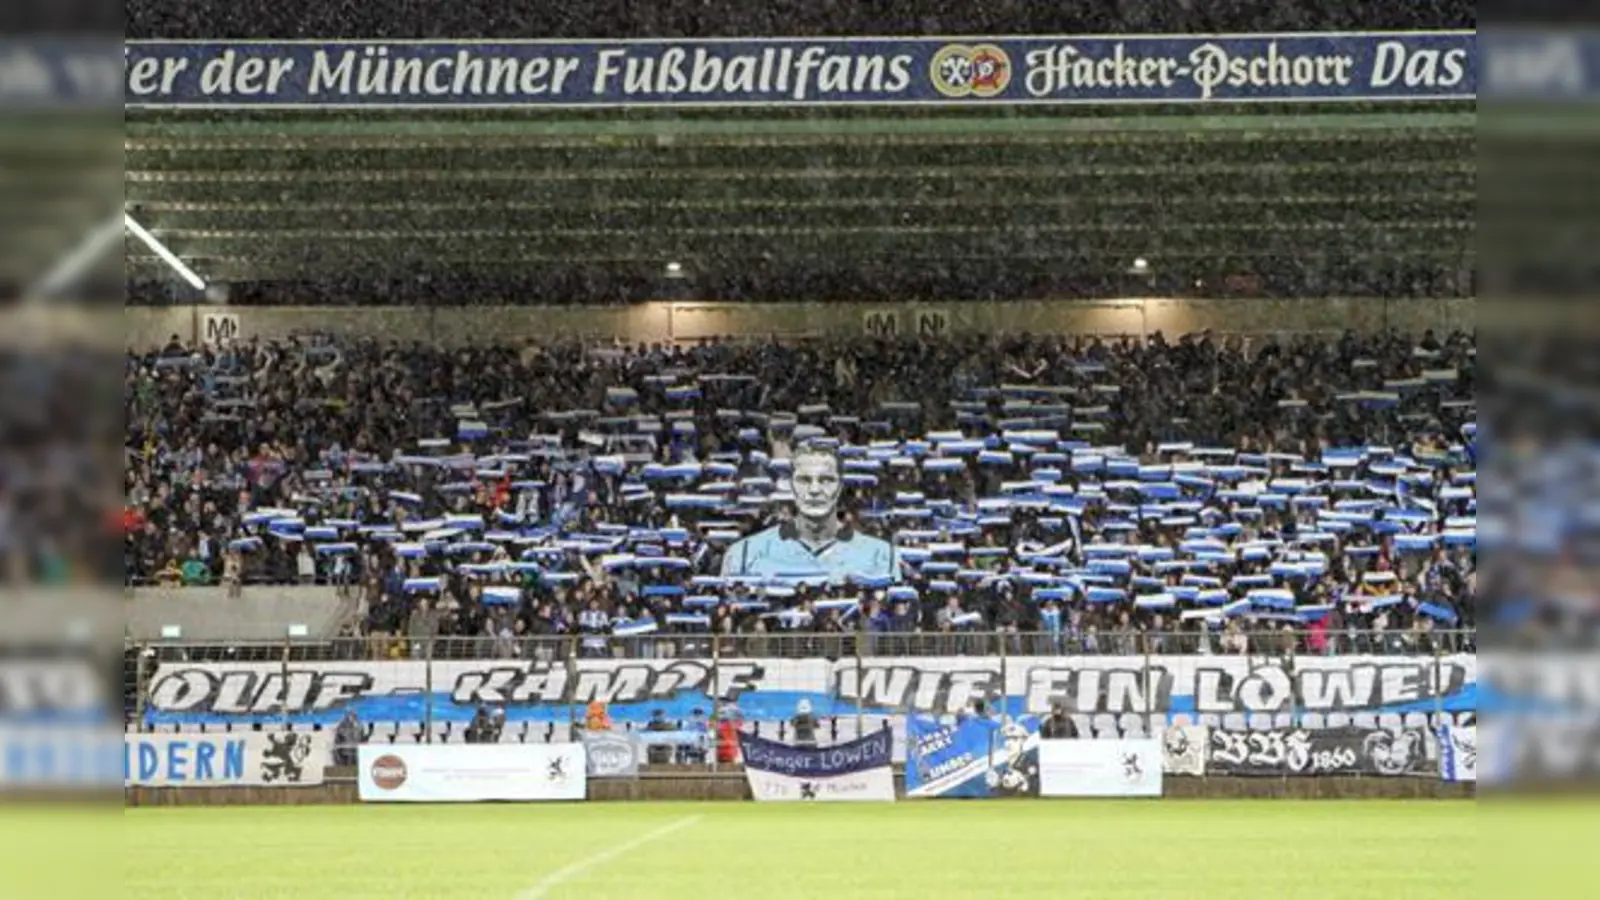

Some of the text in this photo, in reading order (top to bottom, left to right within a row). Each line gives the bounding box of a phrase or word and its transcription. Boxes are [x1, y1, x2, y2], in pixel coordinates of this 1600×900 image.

[201, 50, 294, 95] der
[308, 46, 579, 95] Münchner
[593, 46, 912, 99] Fußballfans
[1025, 41, 1466, 99] Hacker-Pschorr Das
[151, 669, 375, 713] OLAF
[1027, 665, 1172, 714] EIN
[1311, 748, 1356, 769] 1860
